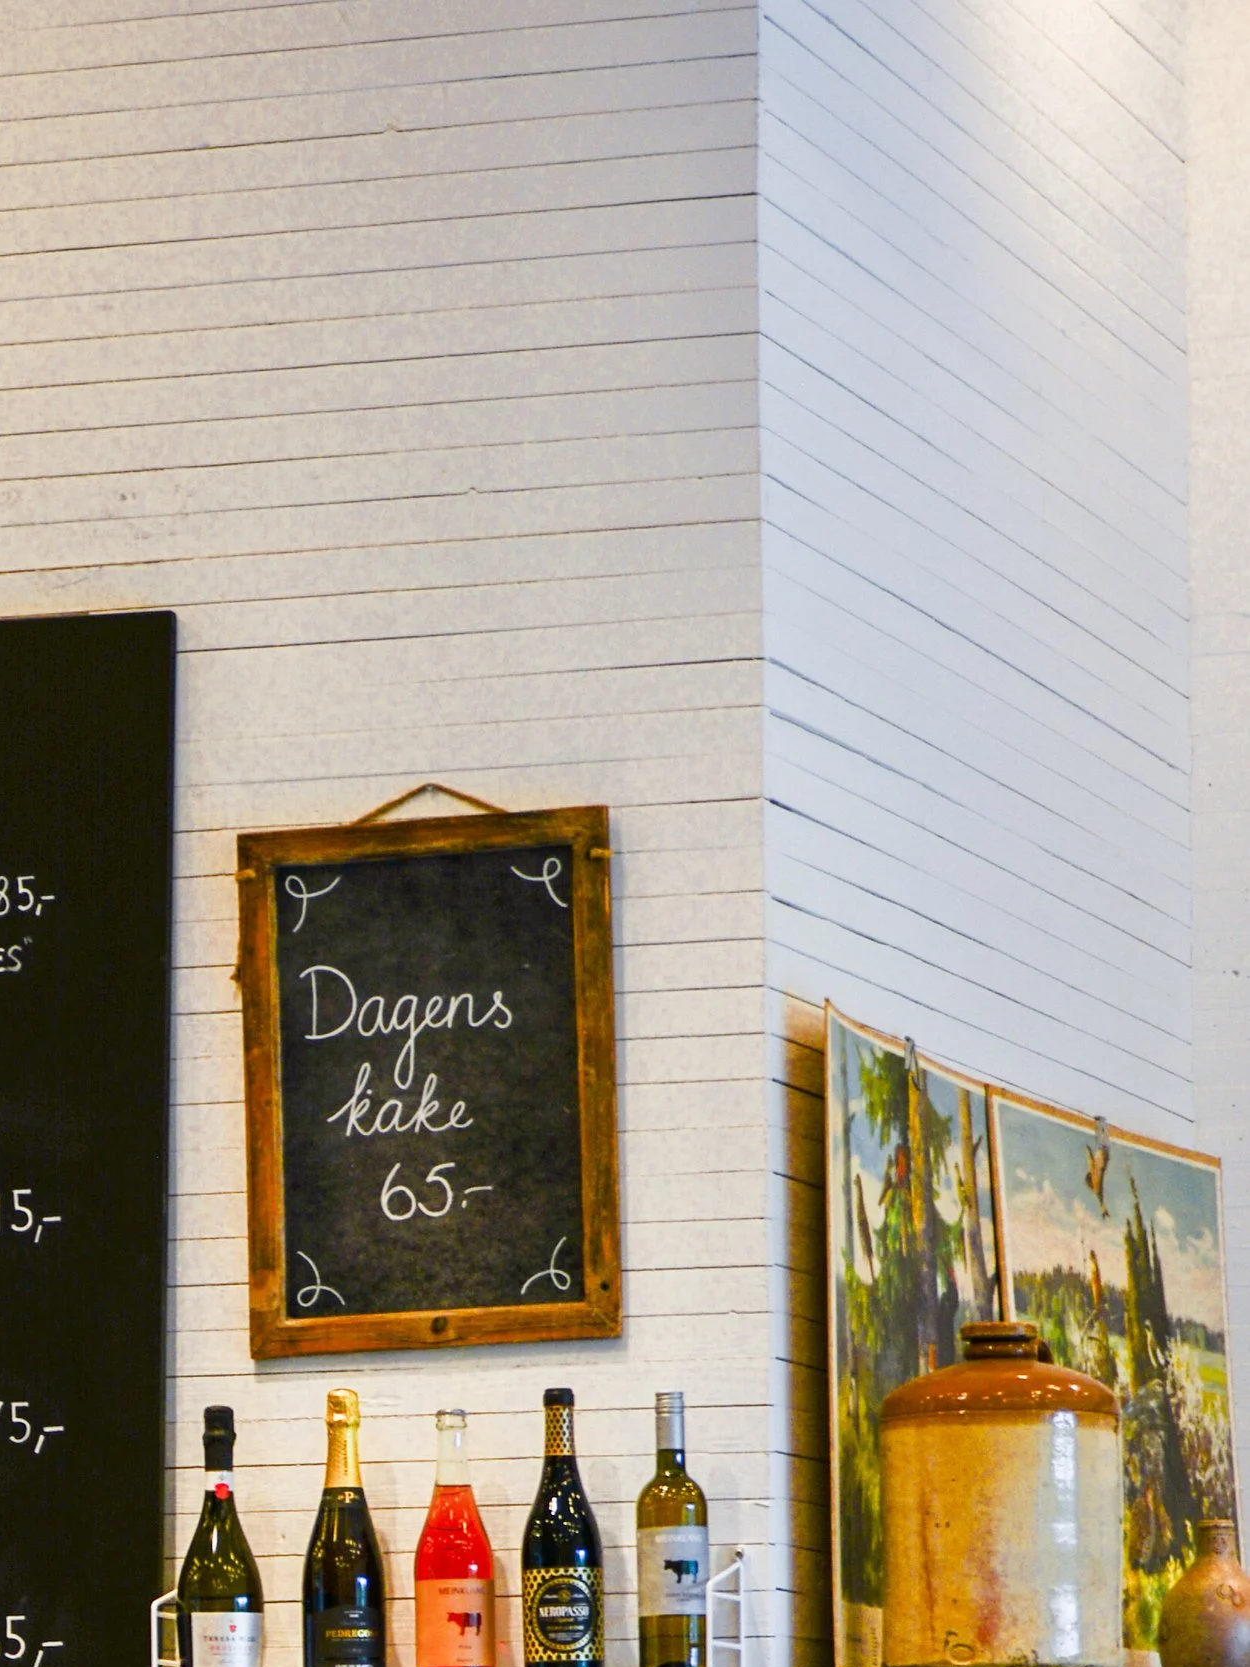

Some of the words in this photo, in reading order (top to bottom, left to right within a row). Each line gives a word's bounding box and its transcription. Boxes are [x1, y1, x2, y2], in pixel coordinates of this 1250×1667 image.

[299, 964, 513, 1090] Dagens
[326, 1061, 474, 1137] kake
[538, 1606, 590, 1618] NEROPASSO
